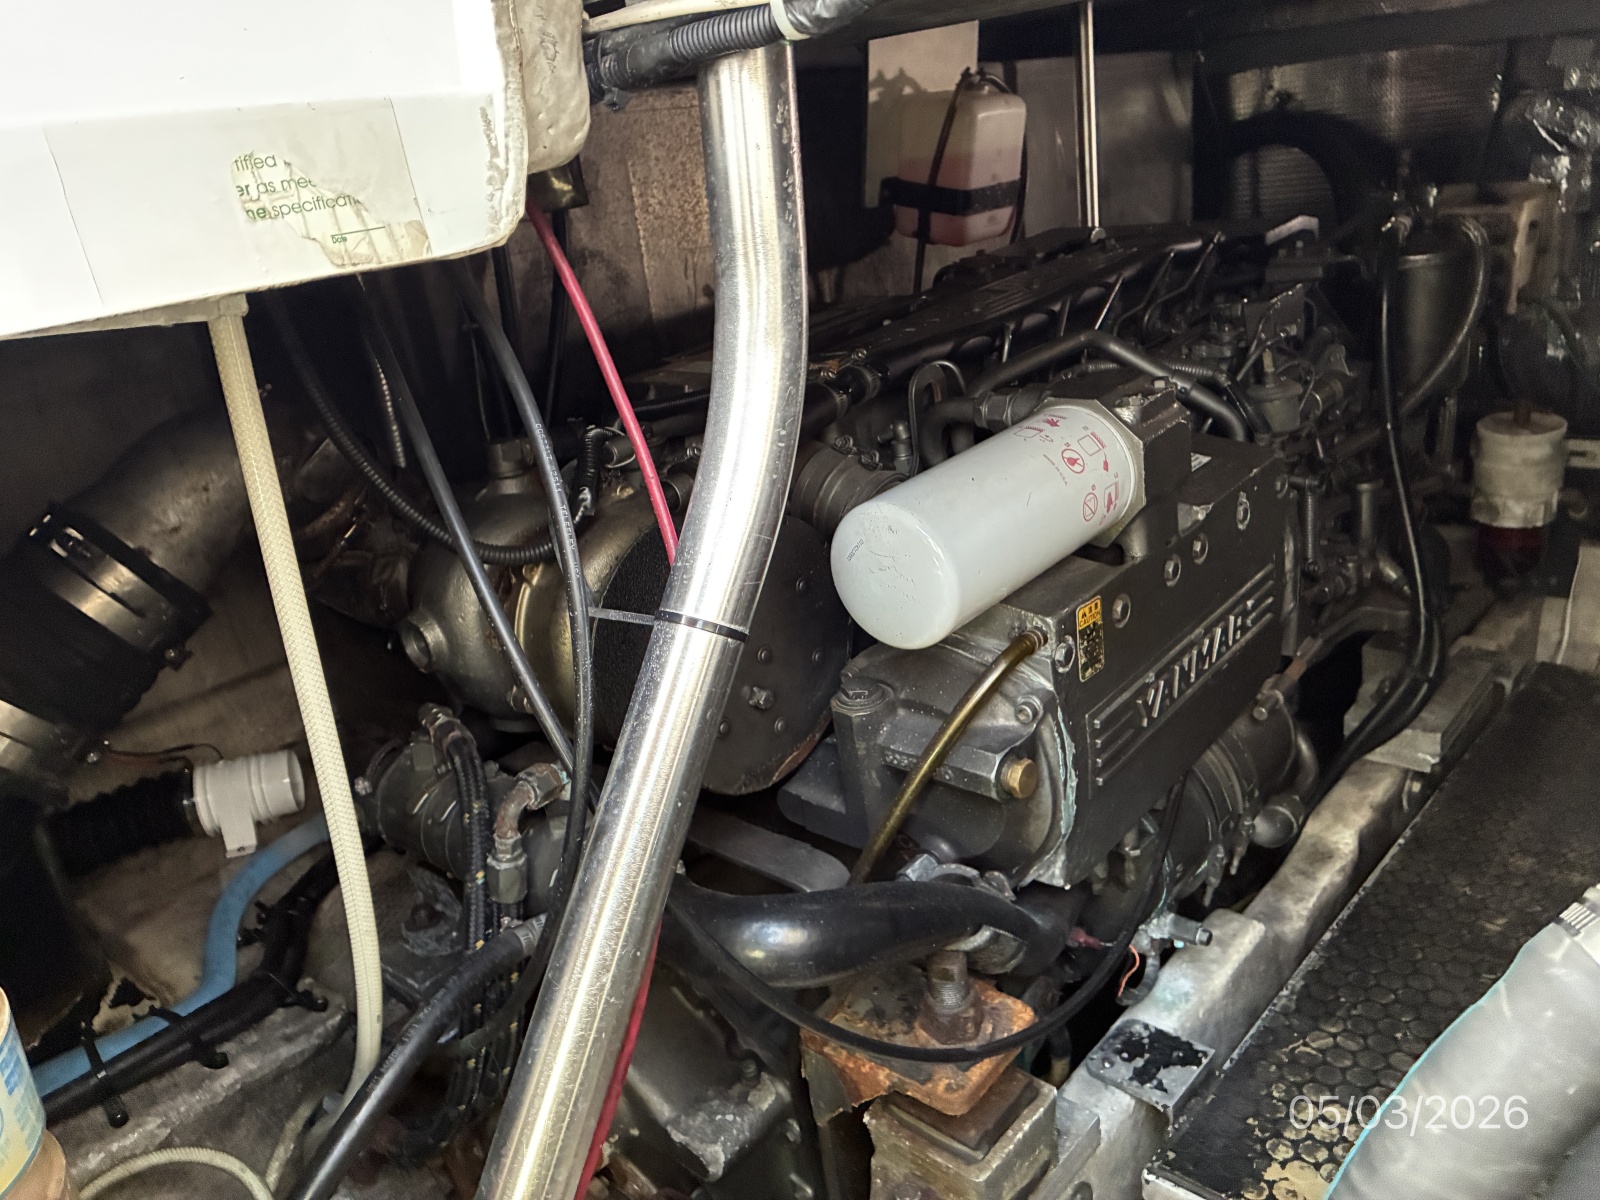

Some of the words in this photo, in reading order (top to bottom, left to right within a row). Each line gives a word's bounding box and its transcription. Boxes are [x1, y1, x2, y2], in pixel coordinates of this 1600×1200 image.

[257, 182, 276, 194] as
[1080, 610, 1101, 627] CAUTION
[1135, 604, 1243, 728] YANMAR
